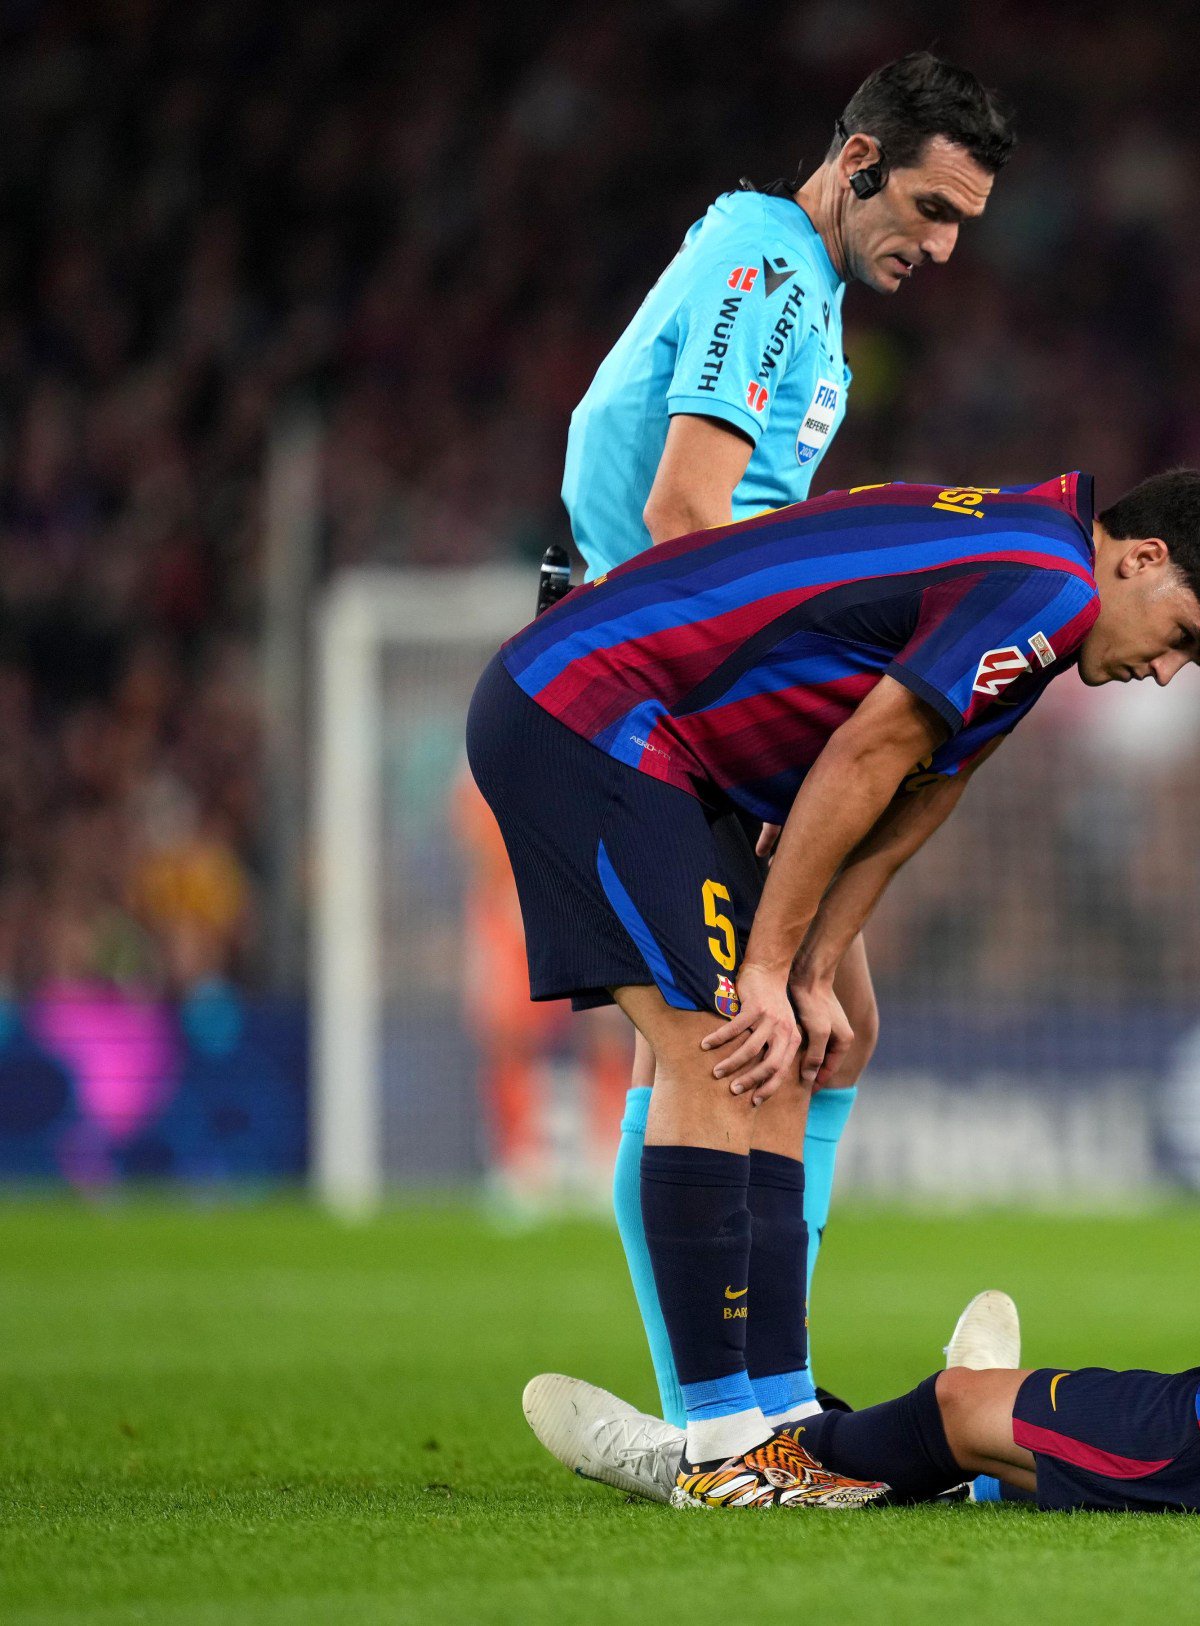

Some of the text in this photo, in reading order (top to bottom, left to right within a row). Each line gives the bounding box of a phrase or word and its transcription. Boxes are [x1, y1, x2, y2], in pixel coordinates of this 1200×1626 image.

[697, 297, 742, 392] WÜRTH
[758, 283, 805, 379] WÜRTH
[804, 417, 830, 435] REFEREE
[815, 385, 838, 411] FIFA
[799, 445, 815, 459] 2026
[701, 878, 736, 971] 5
